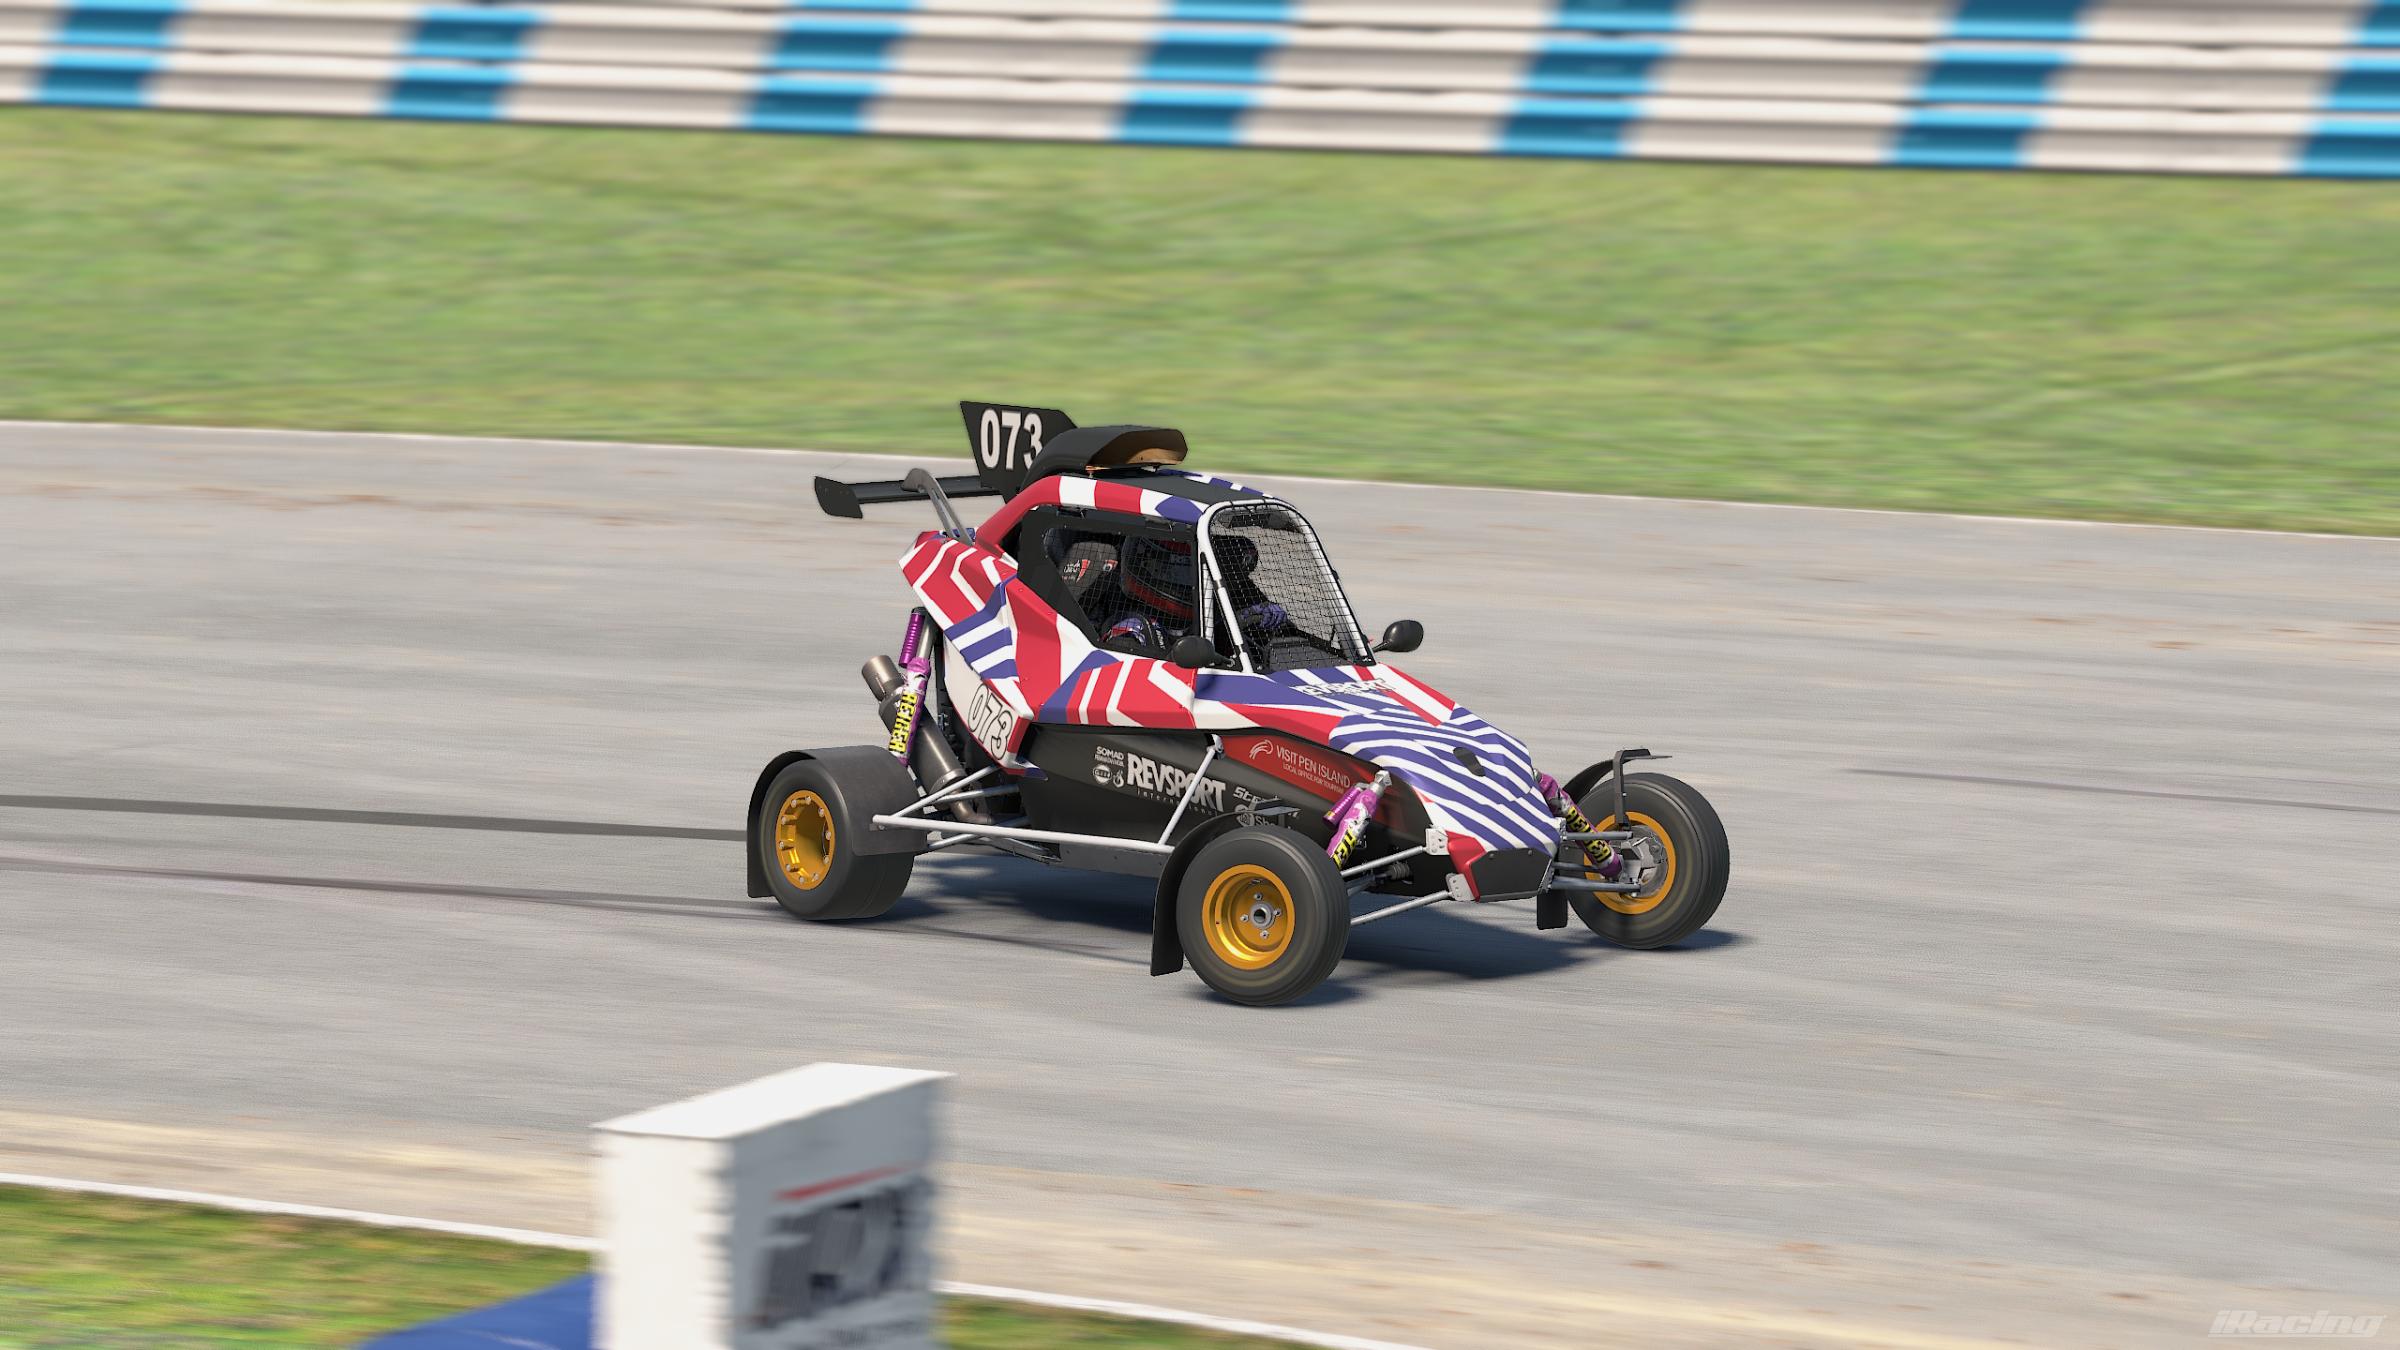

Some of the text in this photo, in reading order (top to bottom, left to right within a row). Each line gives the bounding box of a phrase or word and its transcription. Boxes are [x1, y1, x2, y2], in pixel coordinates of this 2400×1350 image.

[980, 408, 1043, 470] 073
[968, 683, 1013, 760] 073
[1096, 745, 1125, 761] SOMAD
[1127, 752, 1226, 813] REVSPORT
[1276, 744, 1351, 789] VISIT PEN ISLAND
